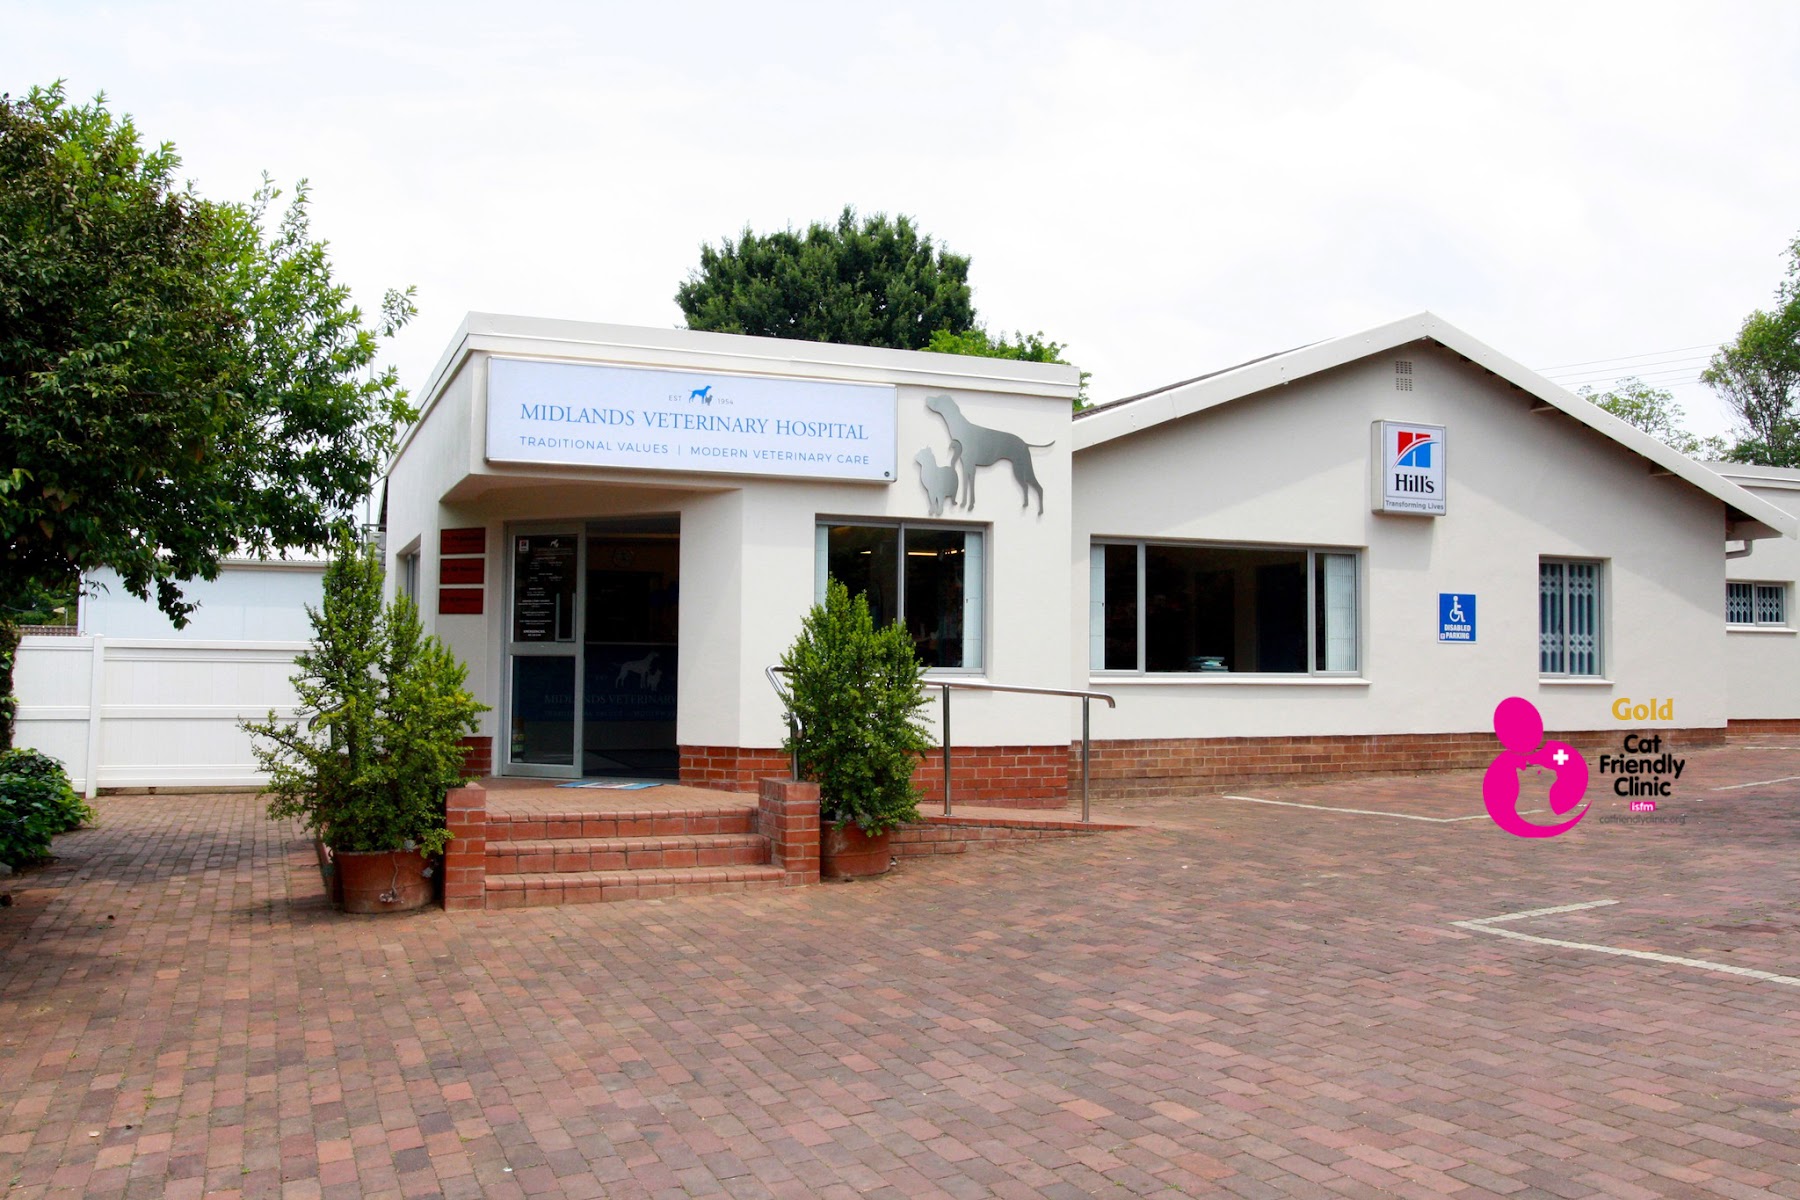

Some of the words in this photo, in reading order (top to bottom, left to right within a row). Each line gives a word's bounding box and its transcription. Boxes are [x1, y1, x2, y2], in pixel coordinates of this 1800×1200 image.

[668, 394, 682, 402] EST
[717, 397, 734, 405] 1954
[520, 403, 635, 427] MIDLANDS
[643, 411, 769, 434] VETERINARY
[776, 419, 869, 440] HOSPITAL
[519, 435, 612, 451] TRADITIONAL
[617, 442, 669, 454] VALUES
[690, 446, 748, 459] MODERN
[753, 449, 832, 463] VETERINARY
[837, 454, 870, 465] CARE
[1395, 473, 1435, 494] Hill's
[1385, 500, 1427, 510] Transforming
[1427, 501, 1444, 510] Lives
